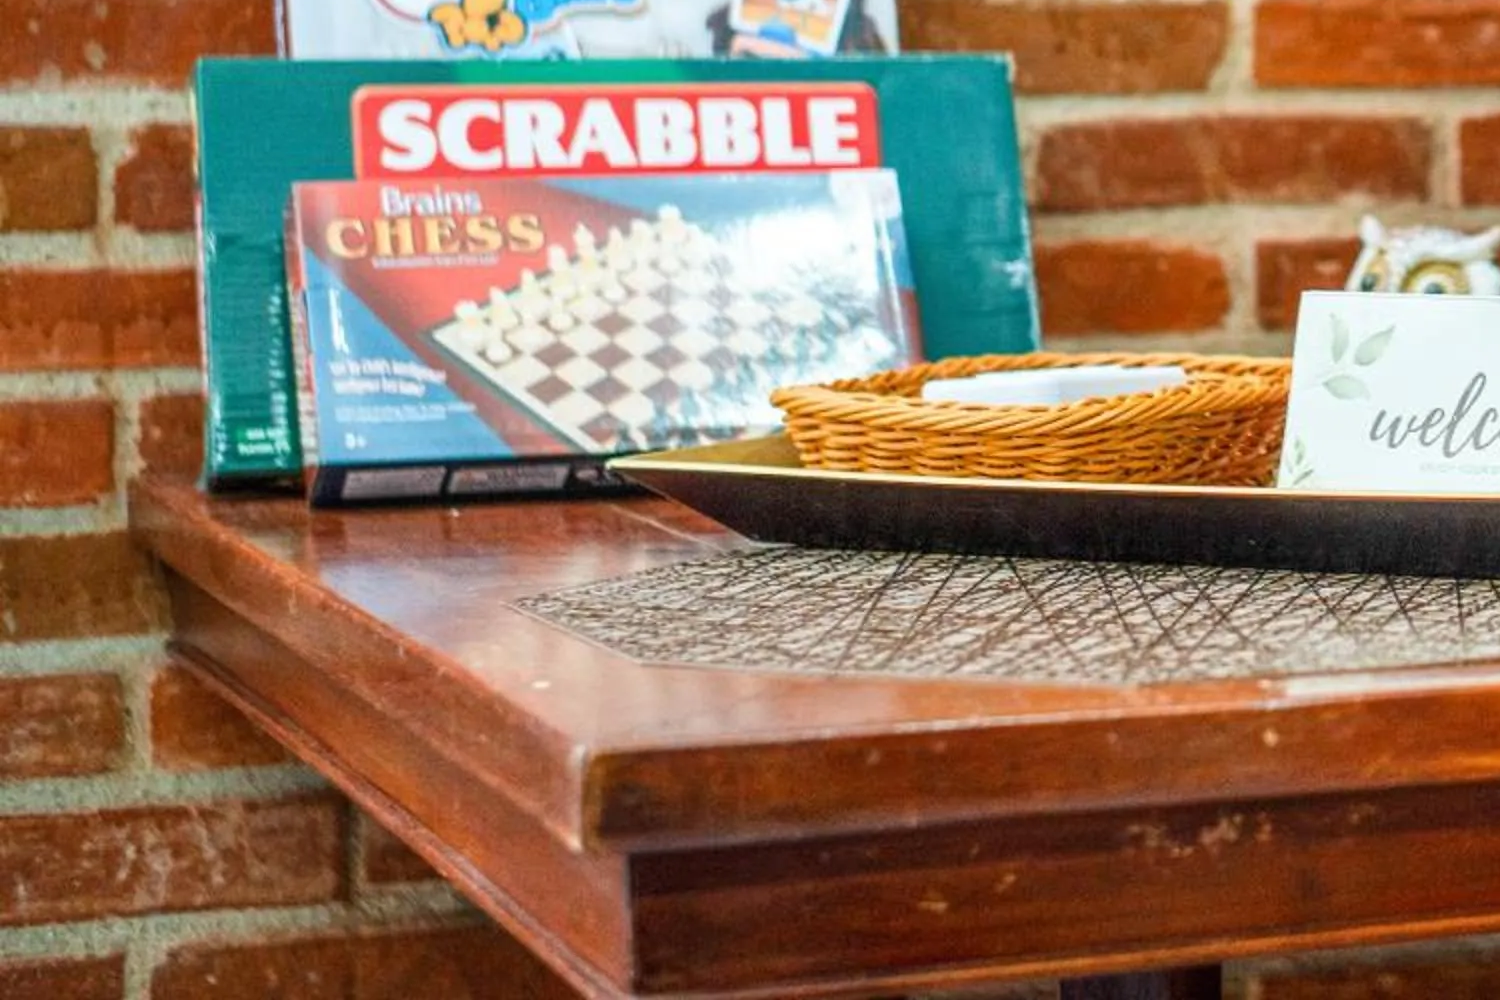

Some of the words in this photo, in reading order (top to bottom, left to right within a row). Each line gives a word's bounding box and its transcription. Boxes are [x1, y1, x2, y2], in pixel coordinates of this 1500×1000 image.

[378, 97, 861, 171] SCRABBLE
[380, 184, 483, 217] Brains
[326, 213, 545, 260] CHESS
